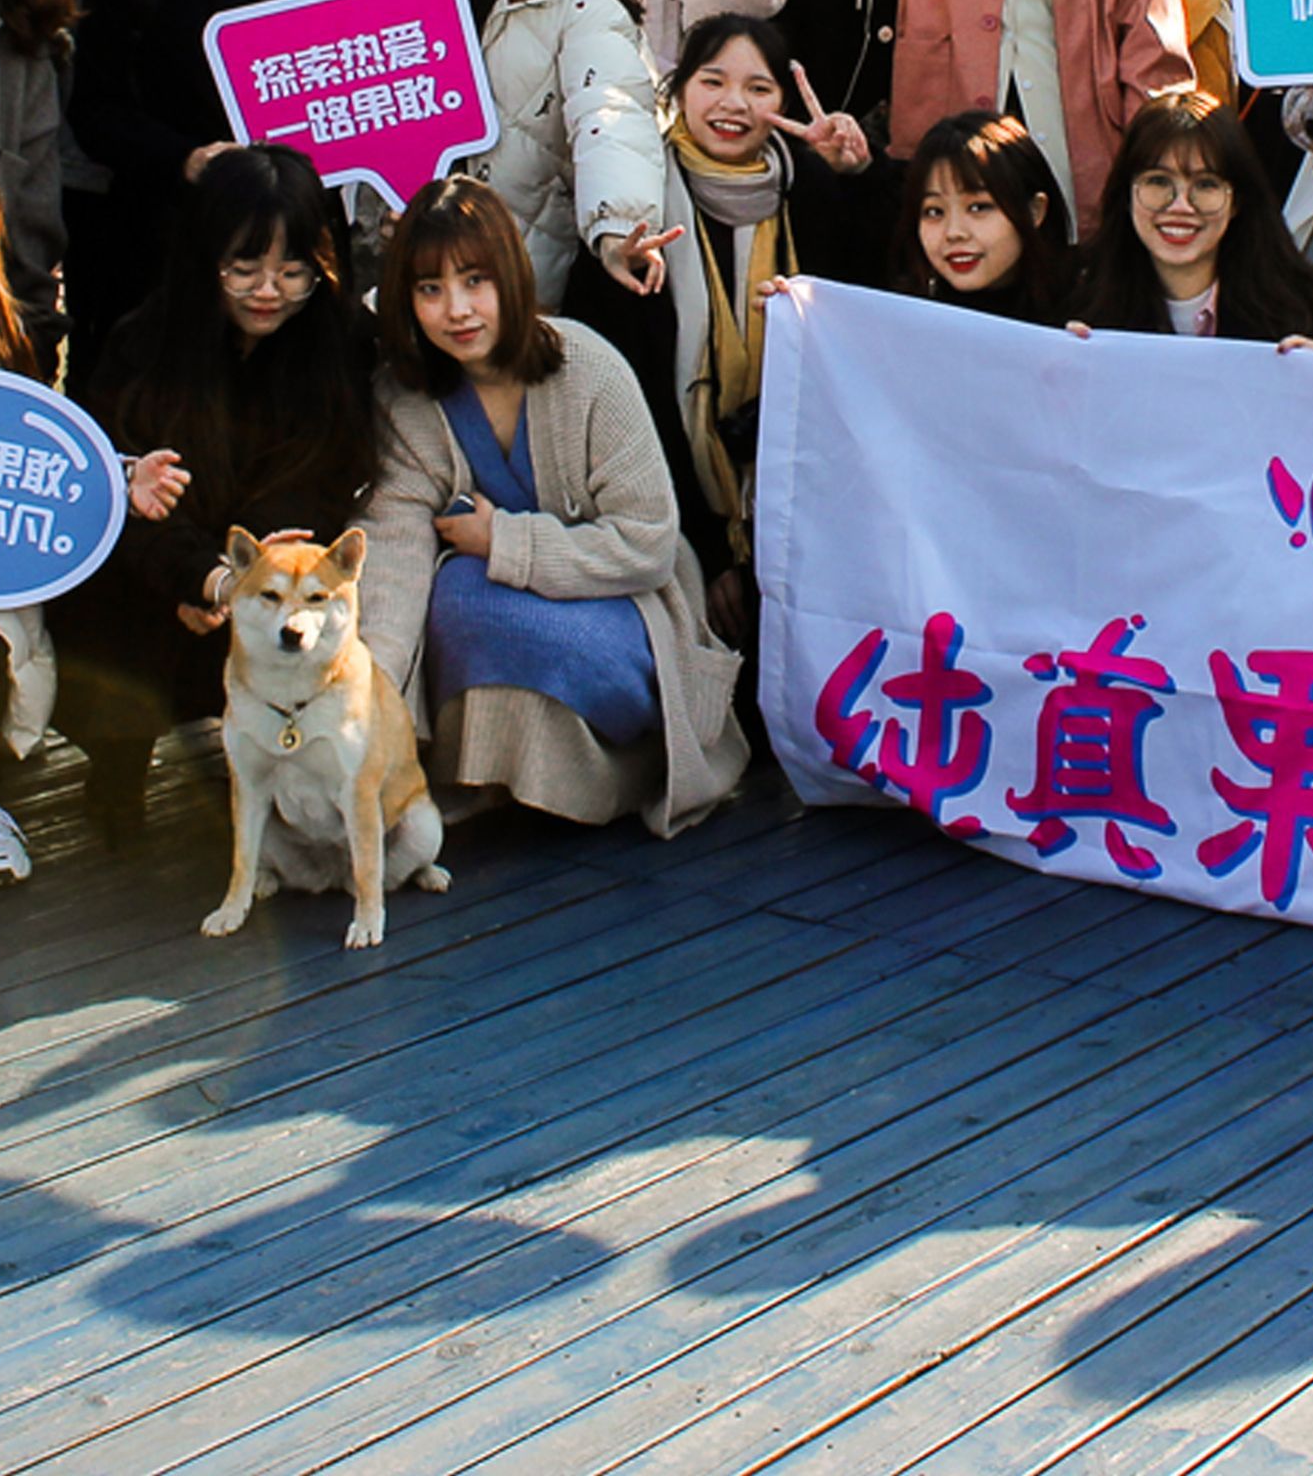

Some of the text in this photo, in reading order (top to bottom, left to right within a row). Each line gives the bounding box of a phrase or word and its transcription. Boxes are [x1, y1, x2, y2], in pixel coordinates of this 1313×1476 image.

[249, 21, 447, 103] 探索热爱，
[265, 74, 463, 144] 一路果敢。
